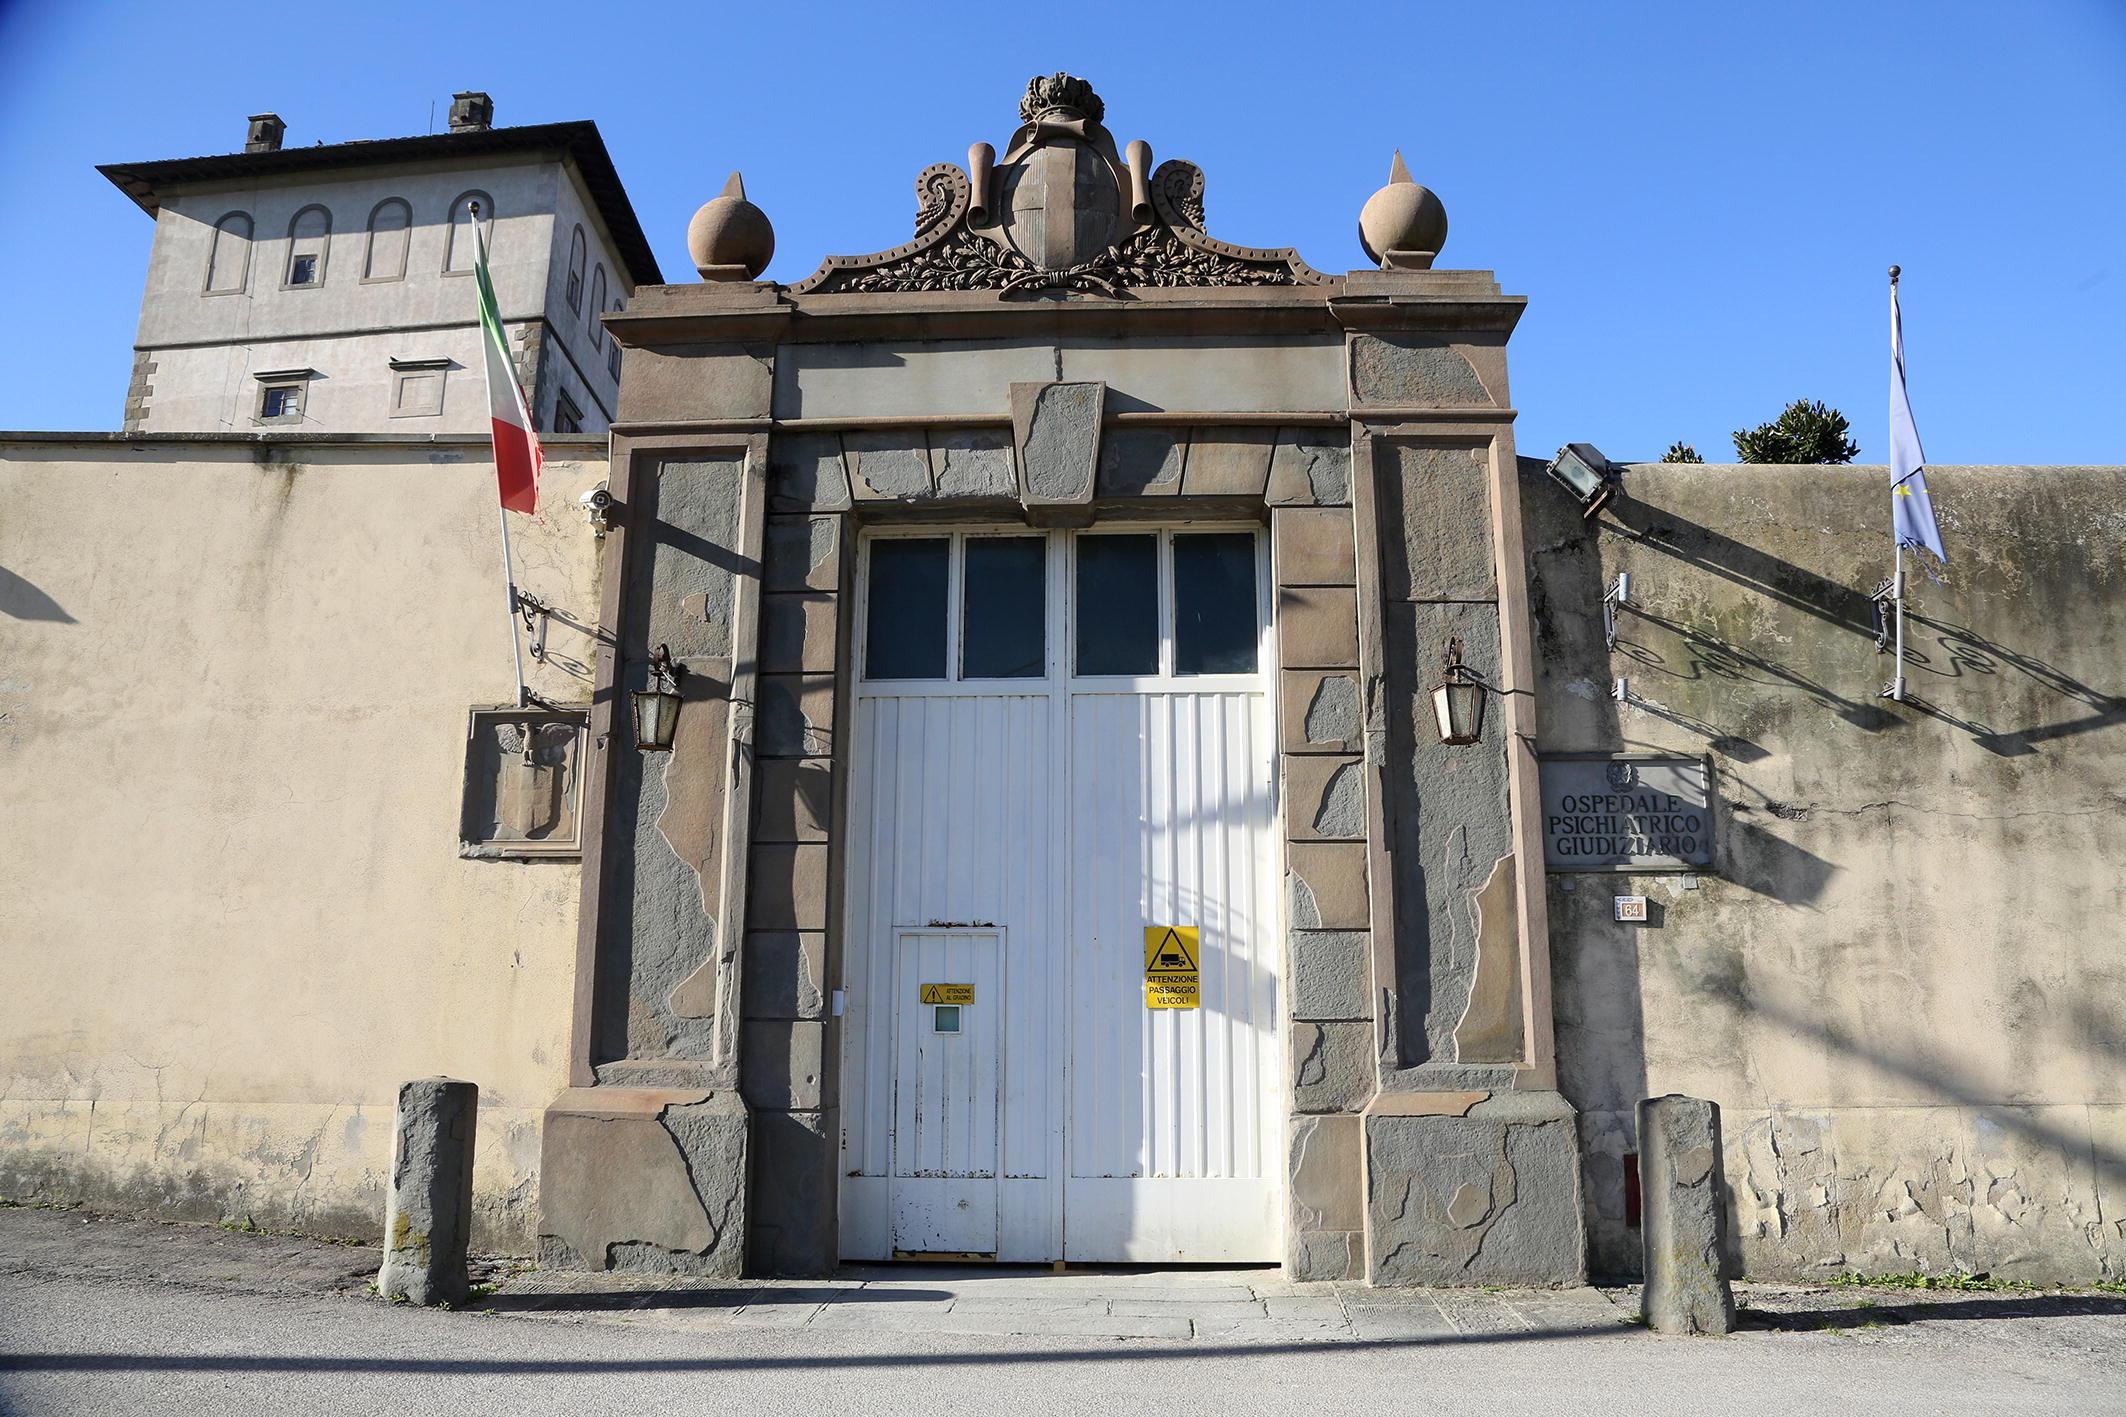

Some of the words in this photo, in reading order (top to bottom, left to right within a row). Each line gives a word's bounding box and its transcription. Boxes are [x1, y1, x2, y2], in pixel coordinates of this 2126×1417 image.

[1562, 795, 1682, 814] OSPEDALE
[1548, 815, 1701, 835] PSICHIATRICO
[1557, 836, 1696, 856] GIUDIZIARIO
[1625, 904, 1640, 917] 64
[1147, 975, 1198, 983] ATTENZIONE
[1149, 986, 1196, 994] PASSAGGIO
